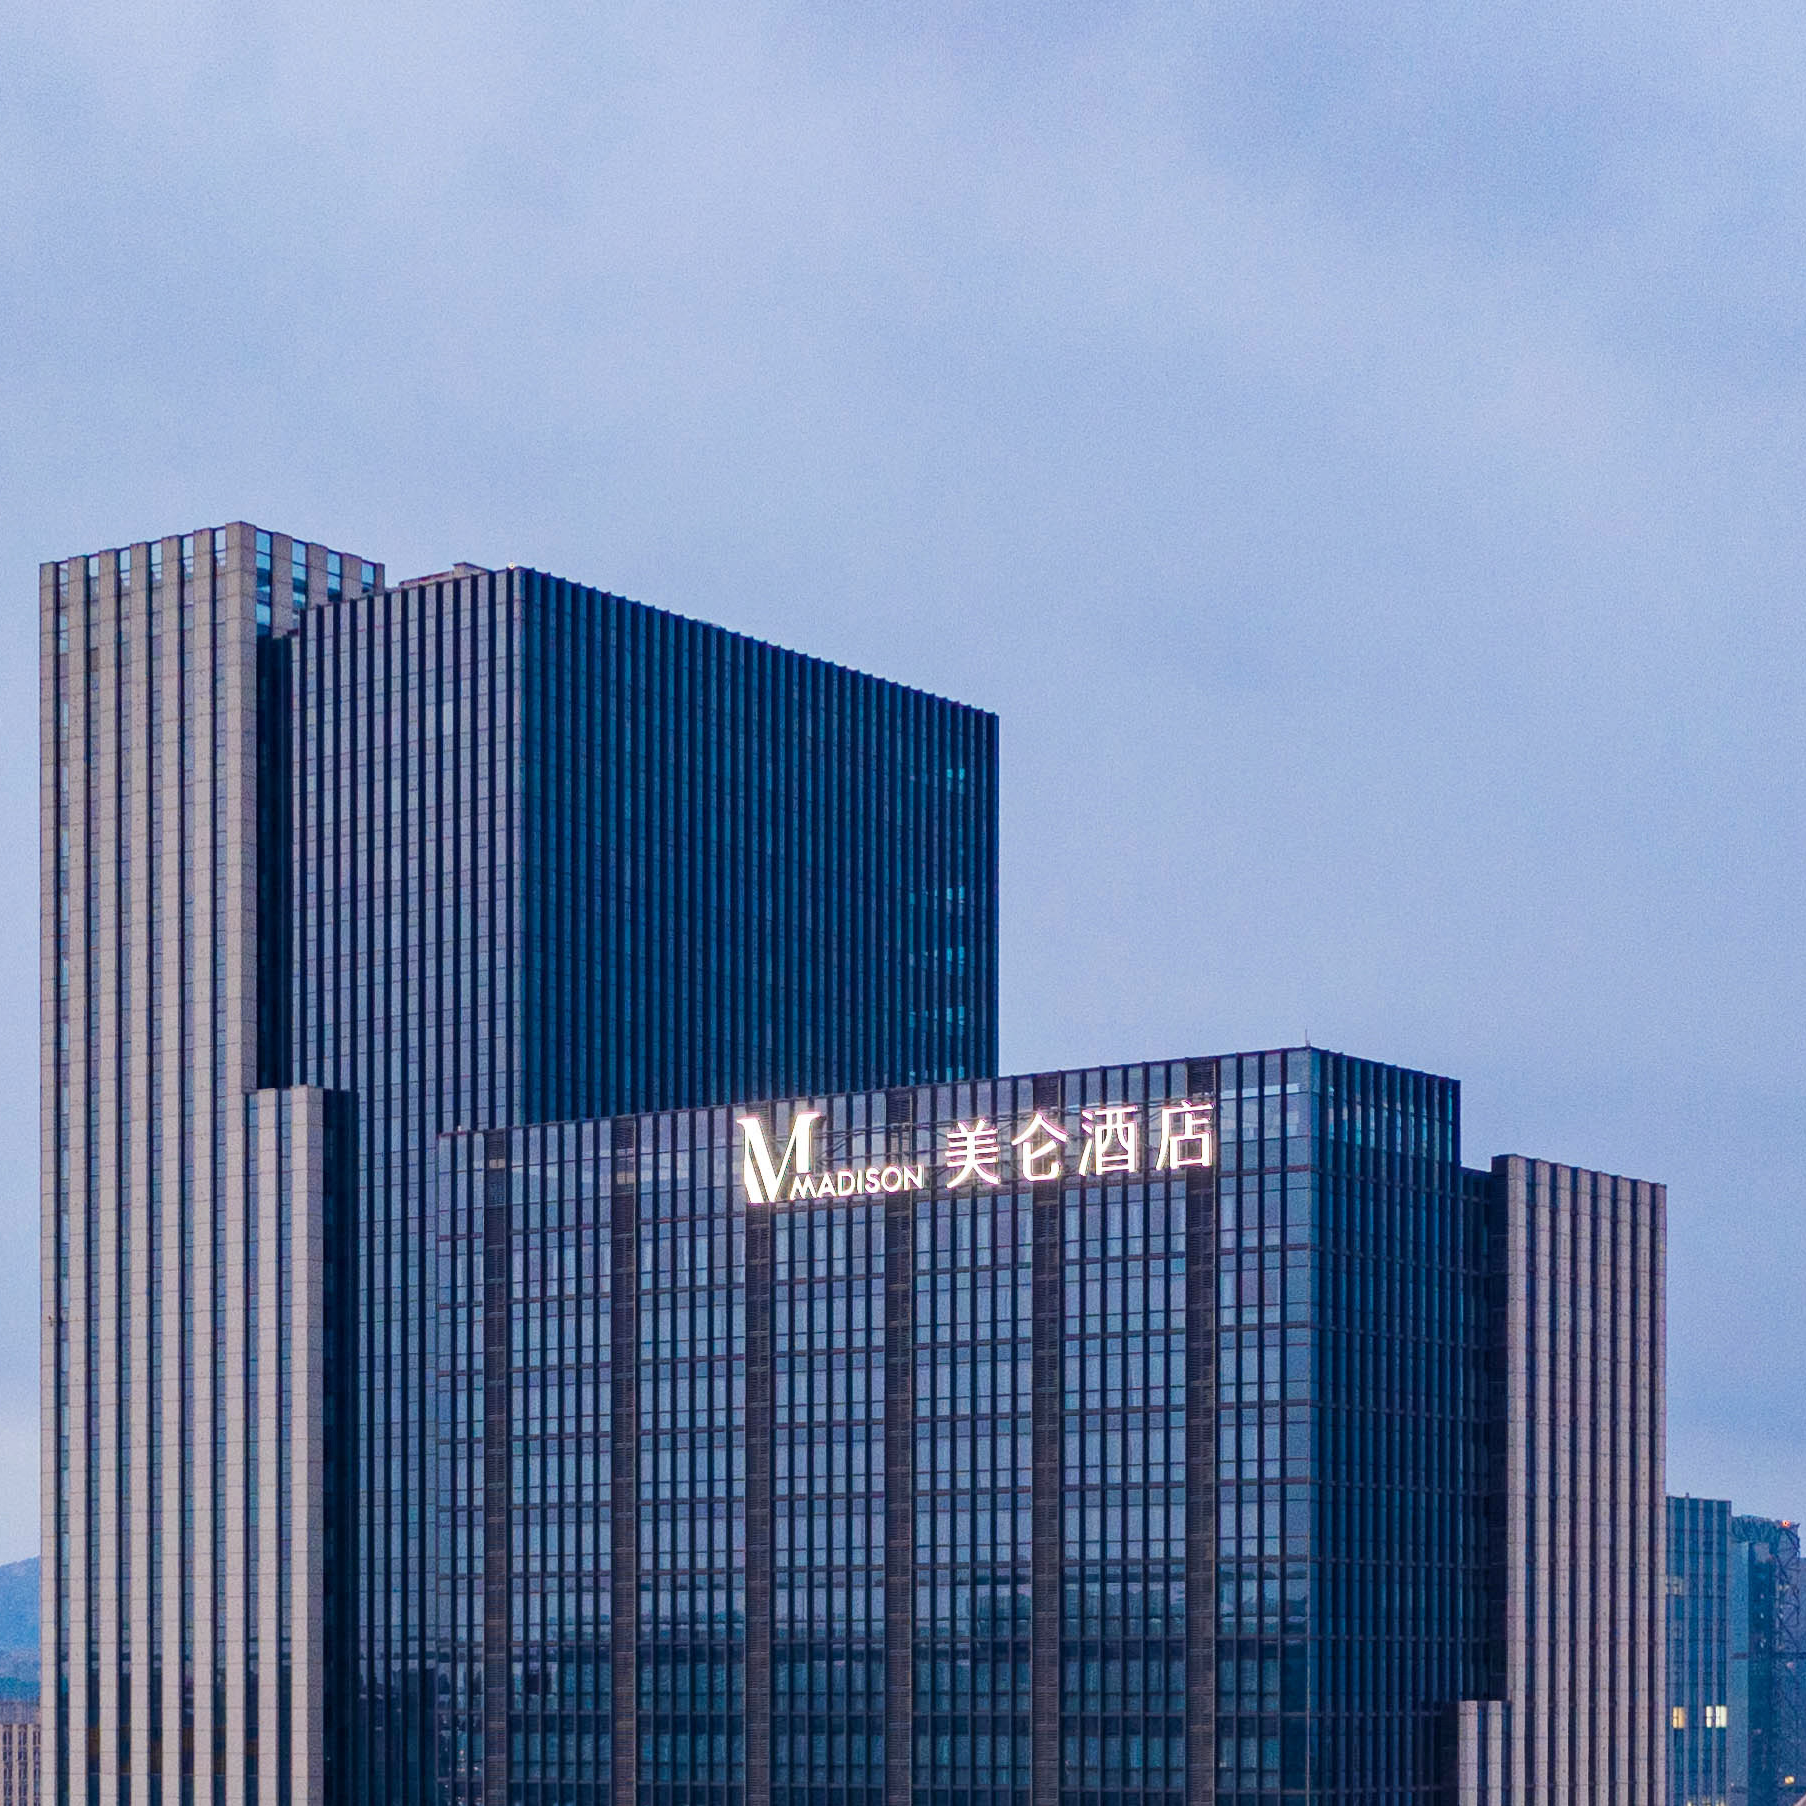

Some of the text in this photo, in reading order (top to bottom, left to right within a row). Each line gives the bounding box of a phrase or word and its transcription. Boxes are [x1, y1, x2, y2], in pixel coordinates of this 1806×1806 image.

[789, 1164, 925, 1200] MADISON
[945, 1099, 1215, 1189] 美仑酒店
